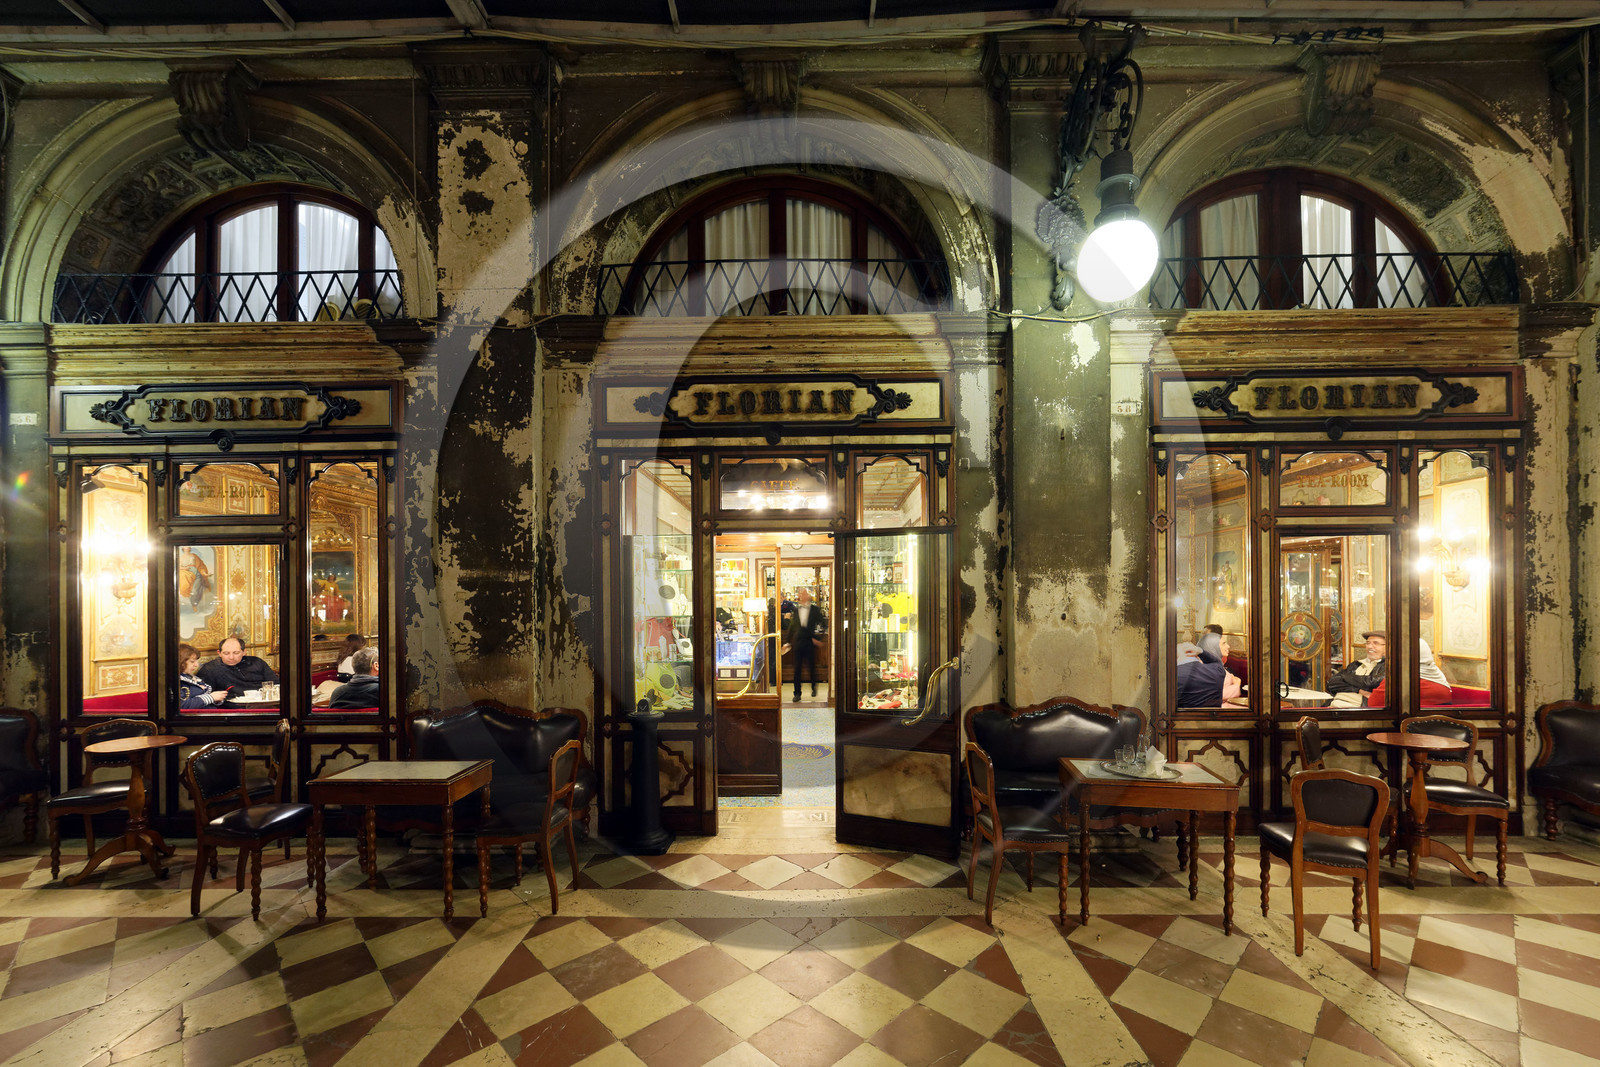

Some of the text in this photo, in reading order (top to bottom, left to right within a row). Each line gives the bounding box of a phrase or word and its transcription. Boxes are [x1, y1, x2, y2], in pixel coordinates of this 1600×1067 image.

[146, 397, 306, 422] FLORIAN
[694, 389, 856, 416] FLORIAN
[1253, 384, 1420, 411] FLORIAN
[197, 485, 265, 498] TEA-ROOM
[1297, 474, 1369, 488] TEA-ROOM
